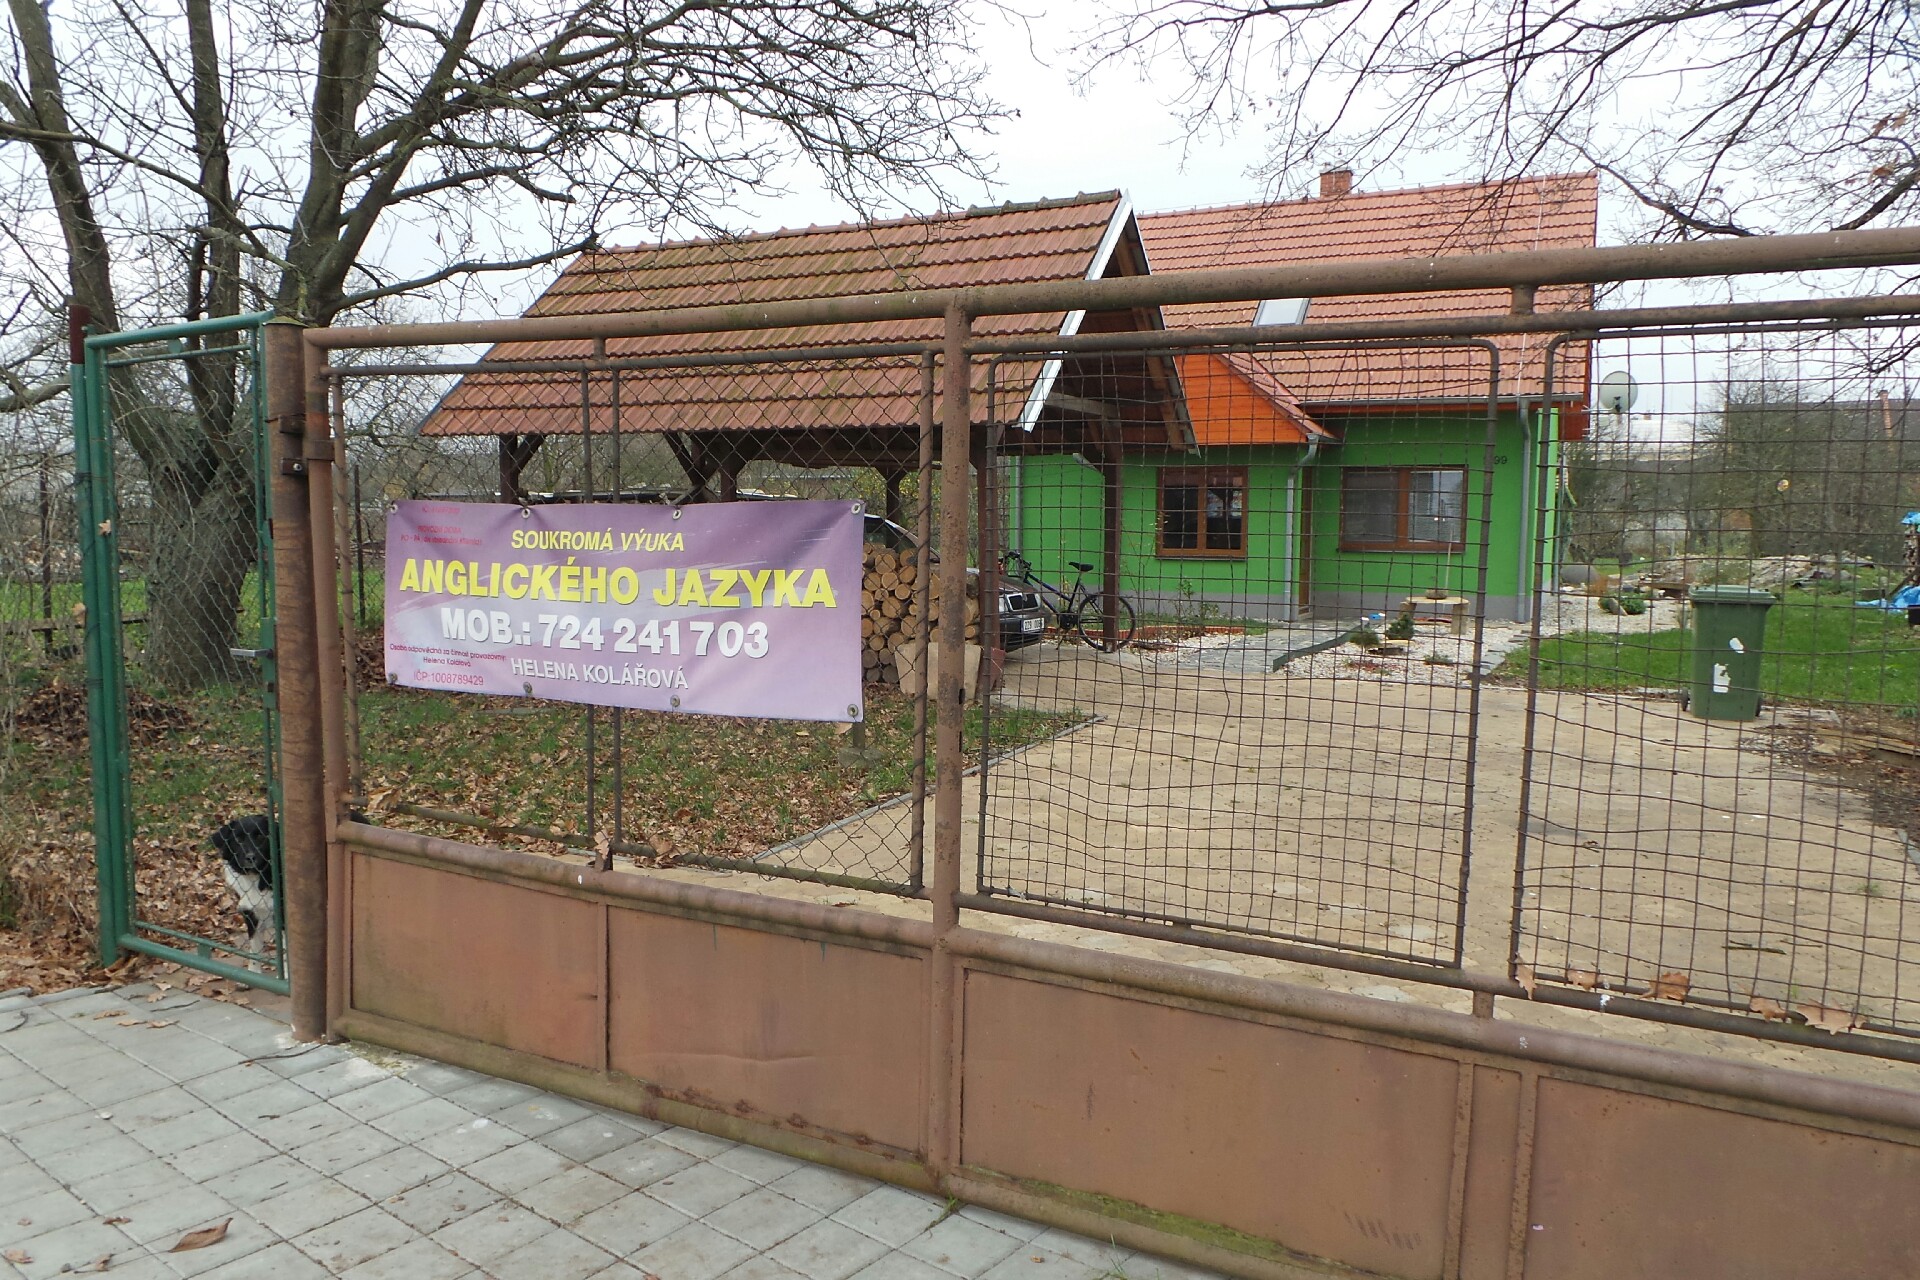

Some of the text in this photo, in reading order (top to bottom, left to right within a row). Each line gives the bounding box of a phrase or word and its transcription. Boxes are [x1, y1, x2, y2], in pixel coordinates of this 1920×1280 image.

[511, 527, 685, 552] SOUKROMÁ VÝUKA
[400, 556, 838, 608] ANGLICKÉHO JAZYKA
[441, 607, 769, 659] MOB.: 724 241 703
[423, 656, 445, 664] Helena
[511, 657, 689, 689] HELENA KOLÁŘOVÁ
